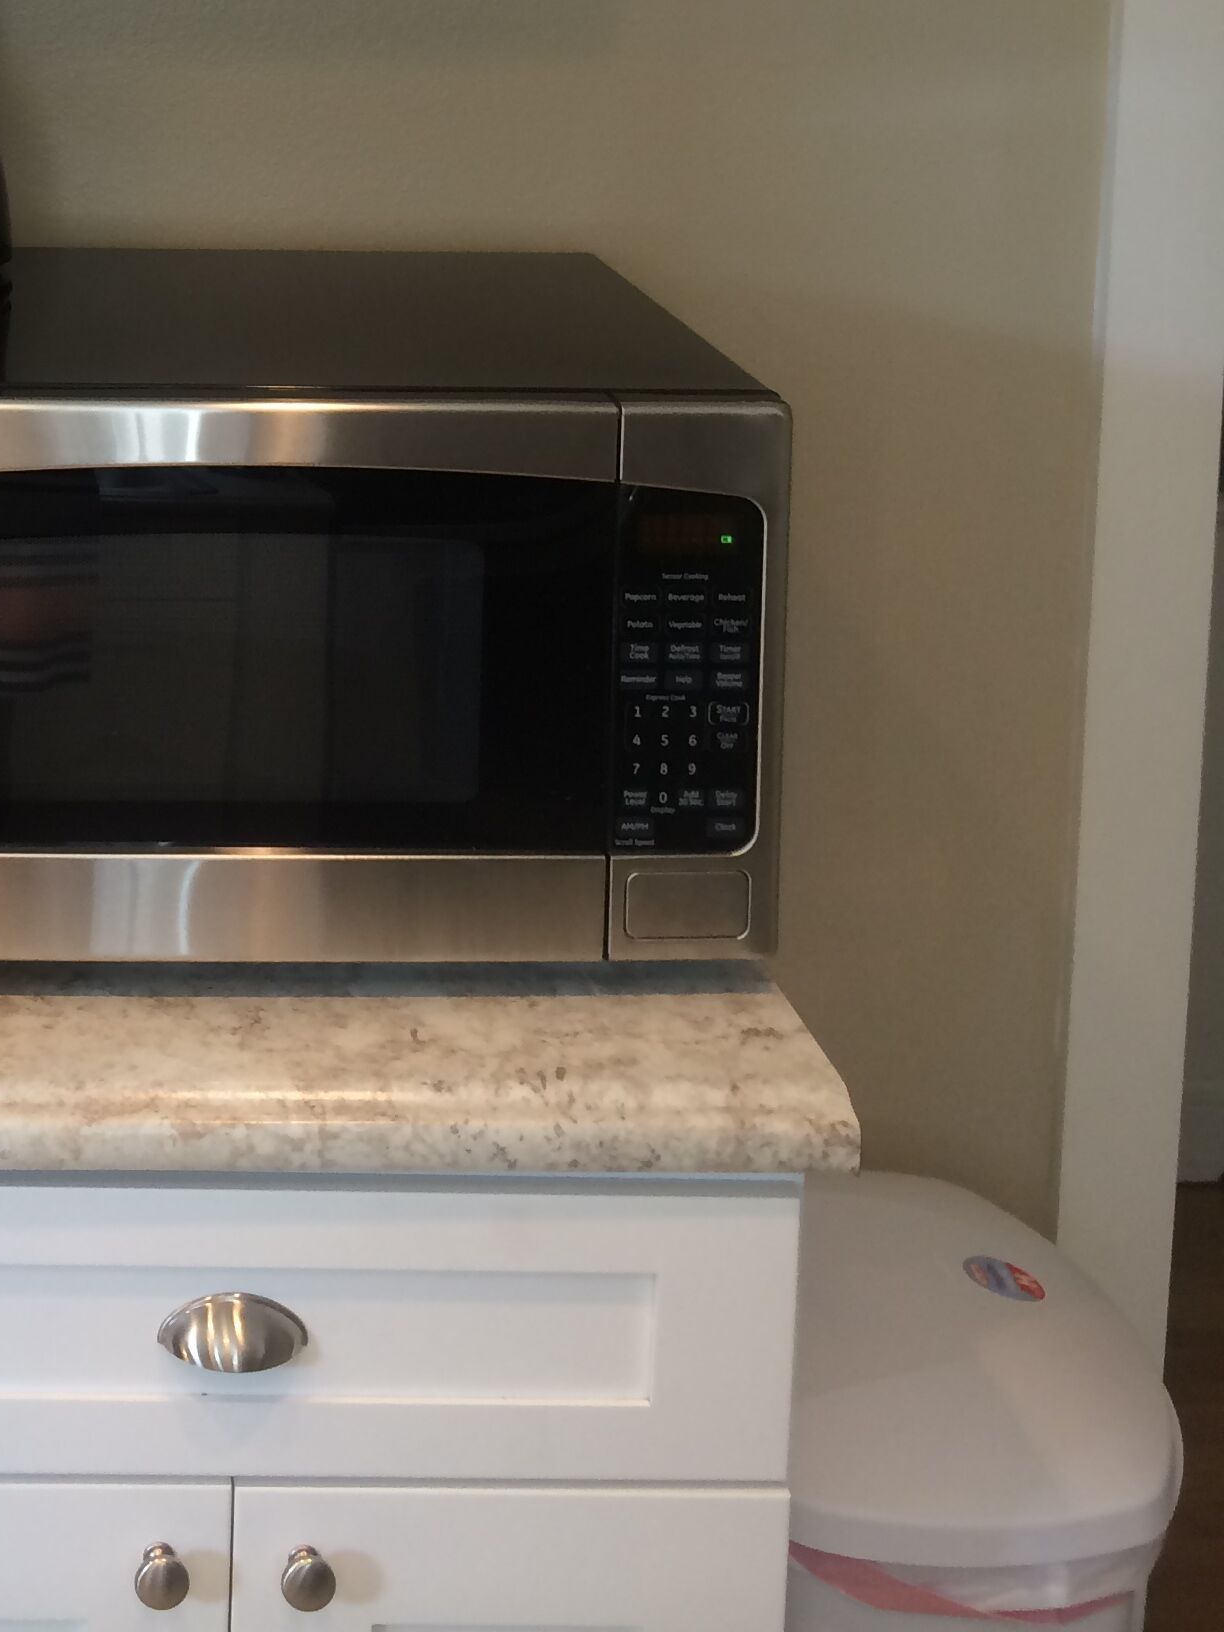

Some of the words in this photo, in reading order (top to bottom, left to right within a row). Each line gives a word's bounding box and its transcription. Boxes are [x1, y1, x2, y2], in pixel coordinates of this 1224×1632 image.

[625, 593, 656, 602] Popcorn
[668, 593, 704, 602] Beverage
[634, 706, 641, 717] 1
[662, 706, 670, 717] 2
[690, 706, 697, 717] 3
[633, 734, 641, 746] 4
[660, 734, 668, 746] 5
[688, 734, 697, 746] 6
[633, 763, 640, 774] 7
[660, 763, 668, 775] 8
[688, 763, 696, 775] 9
[659, 792, 667, 803] 0
